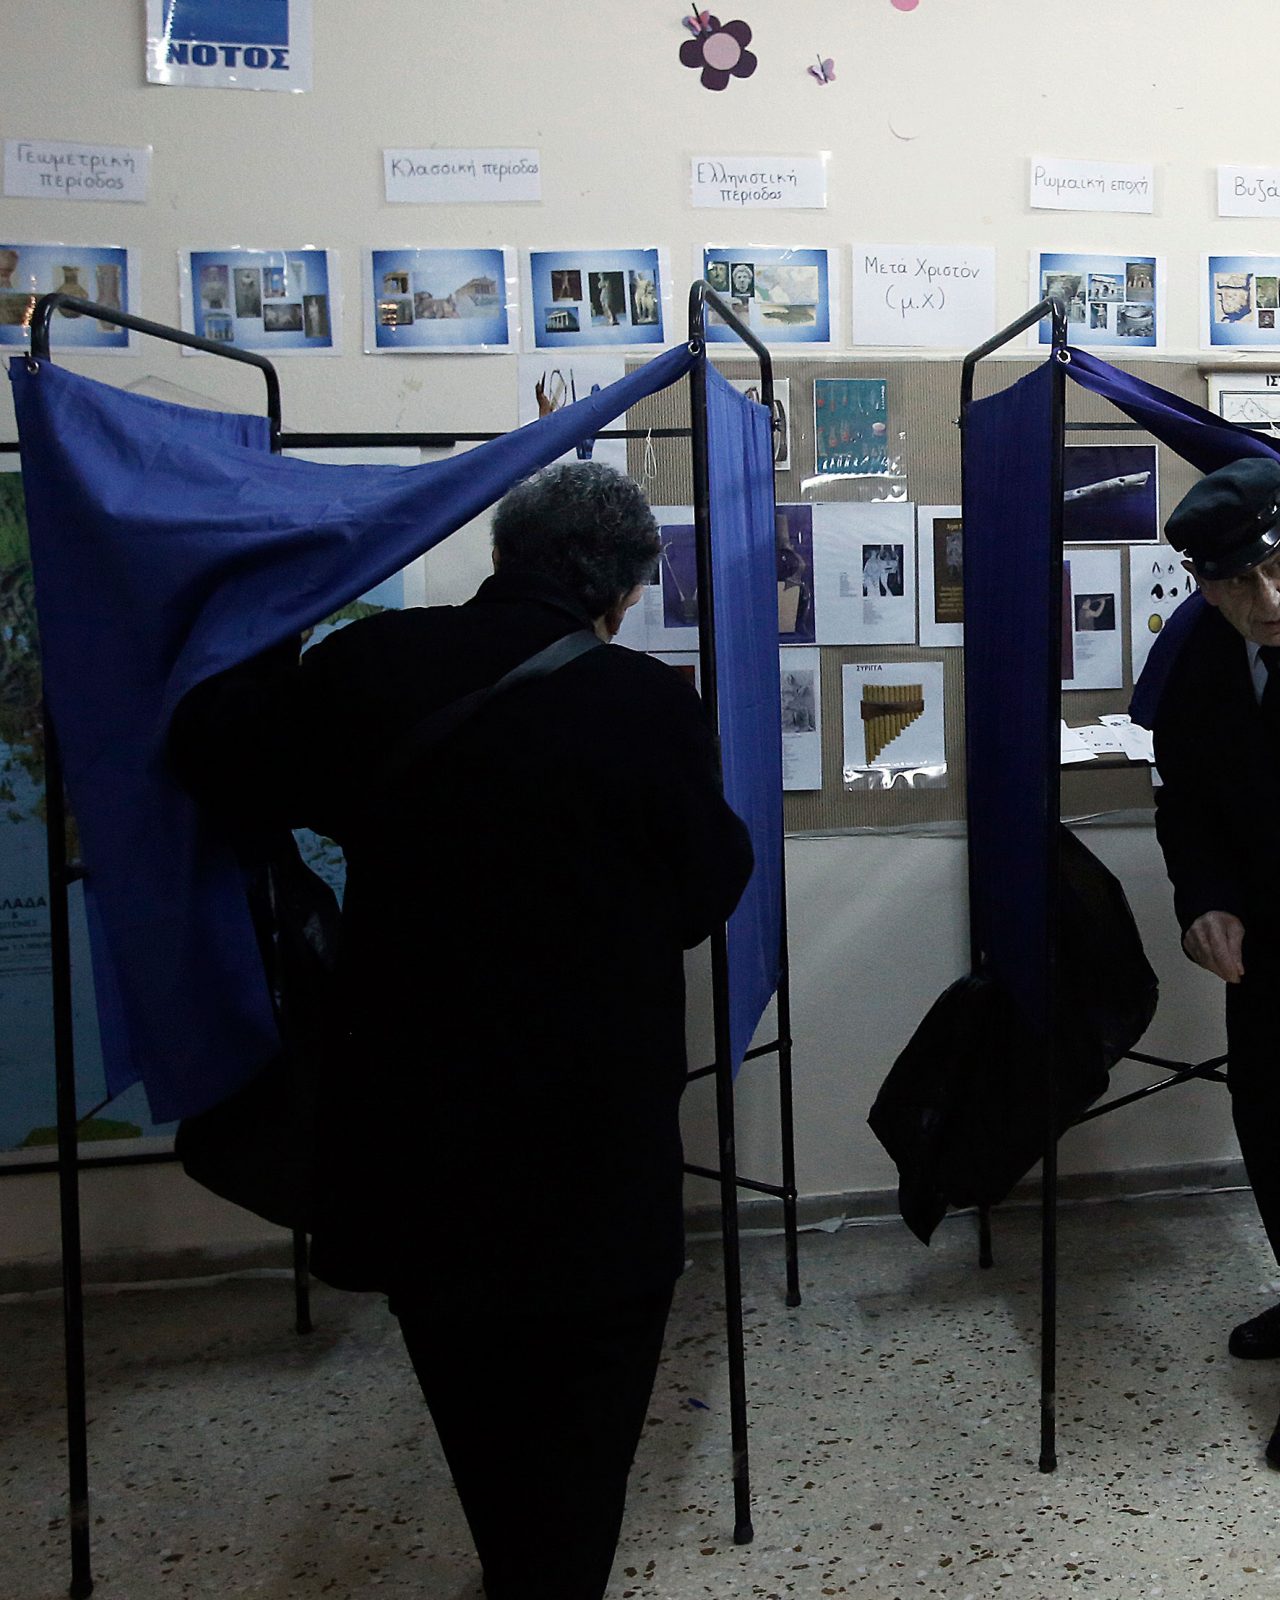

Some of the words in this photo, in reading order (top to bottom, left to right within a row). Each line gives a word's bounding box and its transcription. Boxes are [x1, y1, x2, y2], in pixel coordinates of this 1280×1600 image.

[166, 43, 290, 70] ΝΟΤΟΣ
[17, 143, 135, 173] Γεωμετρική
[482, 158, 540, 182] περίοδος
[40, 170, 124, 195] περίοδος
[697, 162, 797, 187] Ελληνιστική
[1111, 176, 1149, 195] εποχή
[865, 256, 908, 274] Μετά
[914, 258, 980, 283] Χριστόν
[0, 895, 47, 910] ΛΑΔΑ
